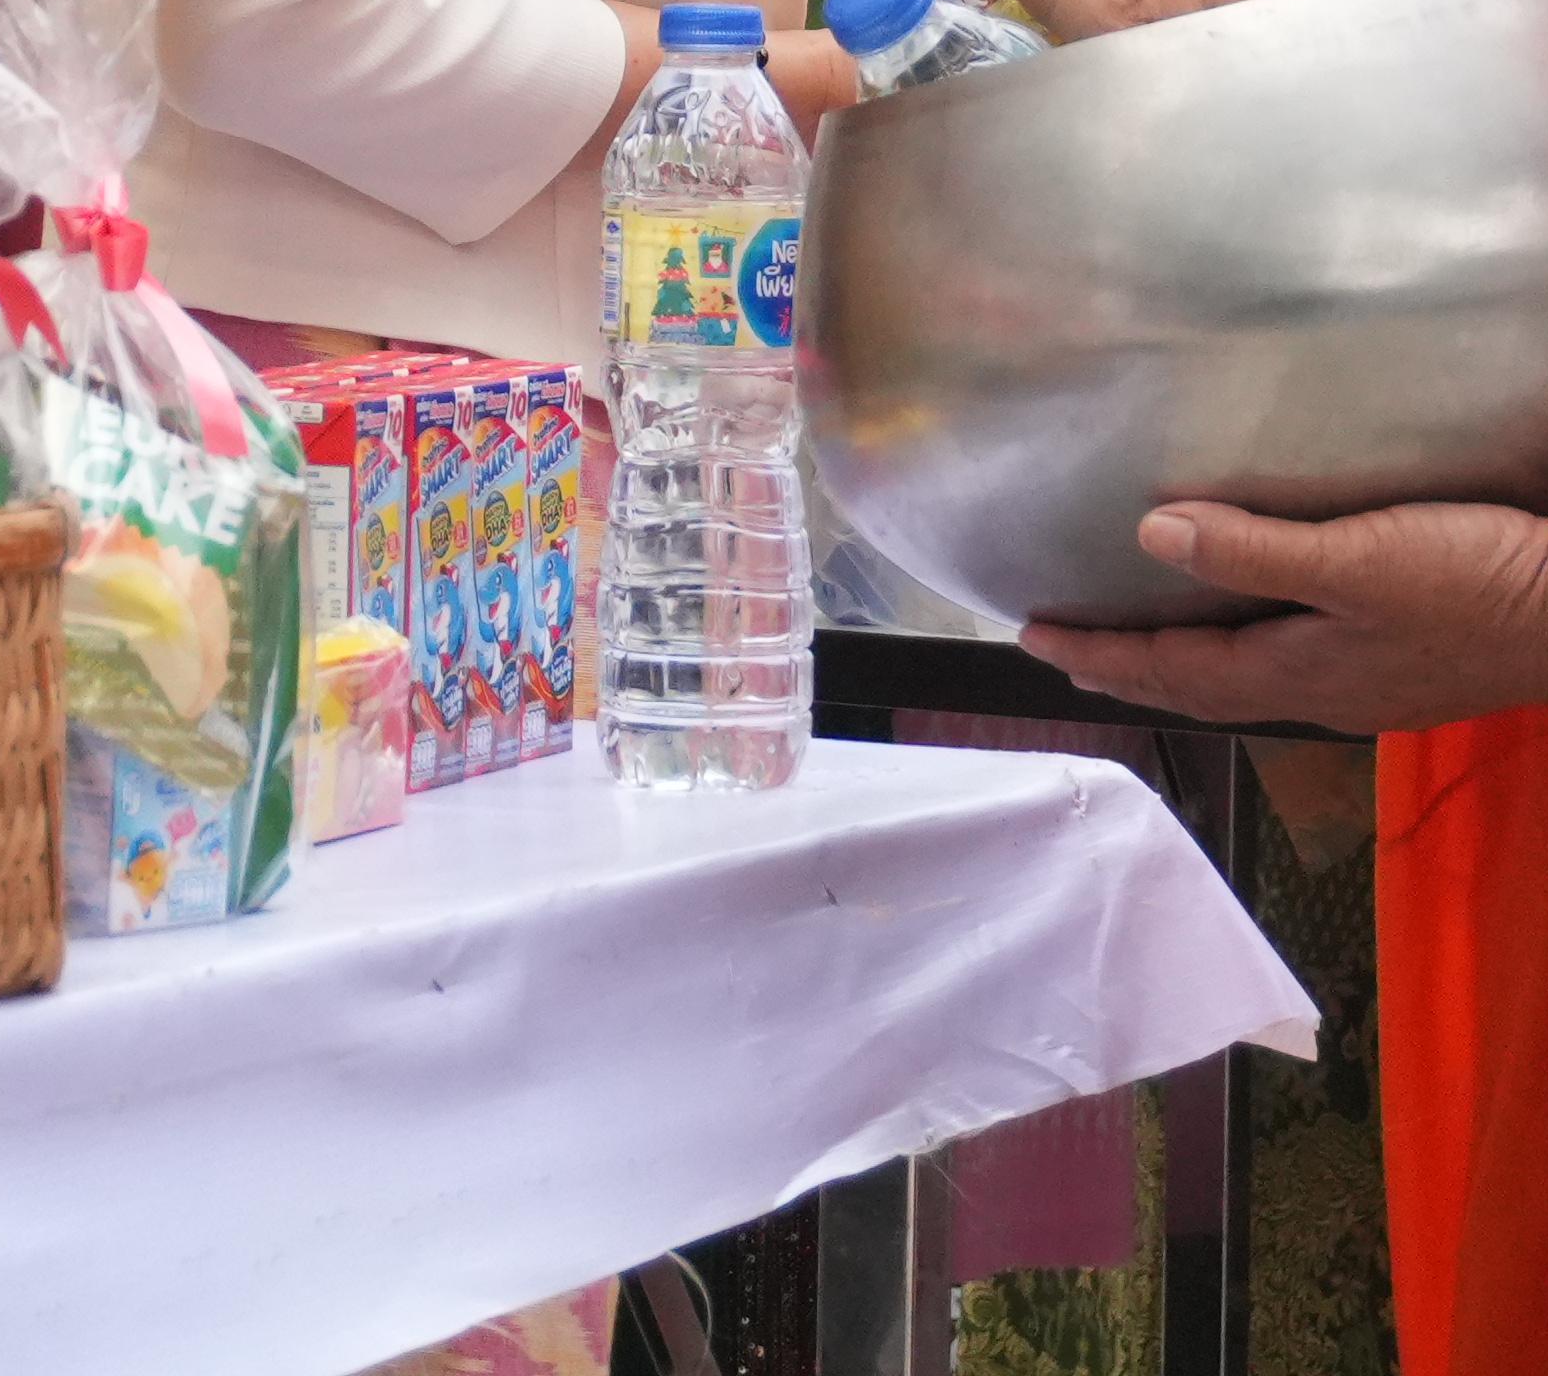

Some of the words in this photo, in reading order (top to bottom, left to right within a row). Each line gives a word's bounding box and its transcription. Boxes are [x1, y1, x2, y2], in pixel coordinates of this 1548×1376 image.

[510, 390, 526, 421] 10
[567, 379, 582, 410] 10
[389, 409, 402, 440] 10
[457, 400, 471, 431] 10
[473, 432, 517, 497] SMART
[531, 421, 576, 485] SMART
[420, 444, 463, 508] SMART
[68, 447, 251, 547] CAKE
[486, 518, 509, 542] DHA
